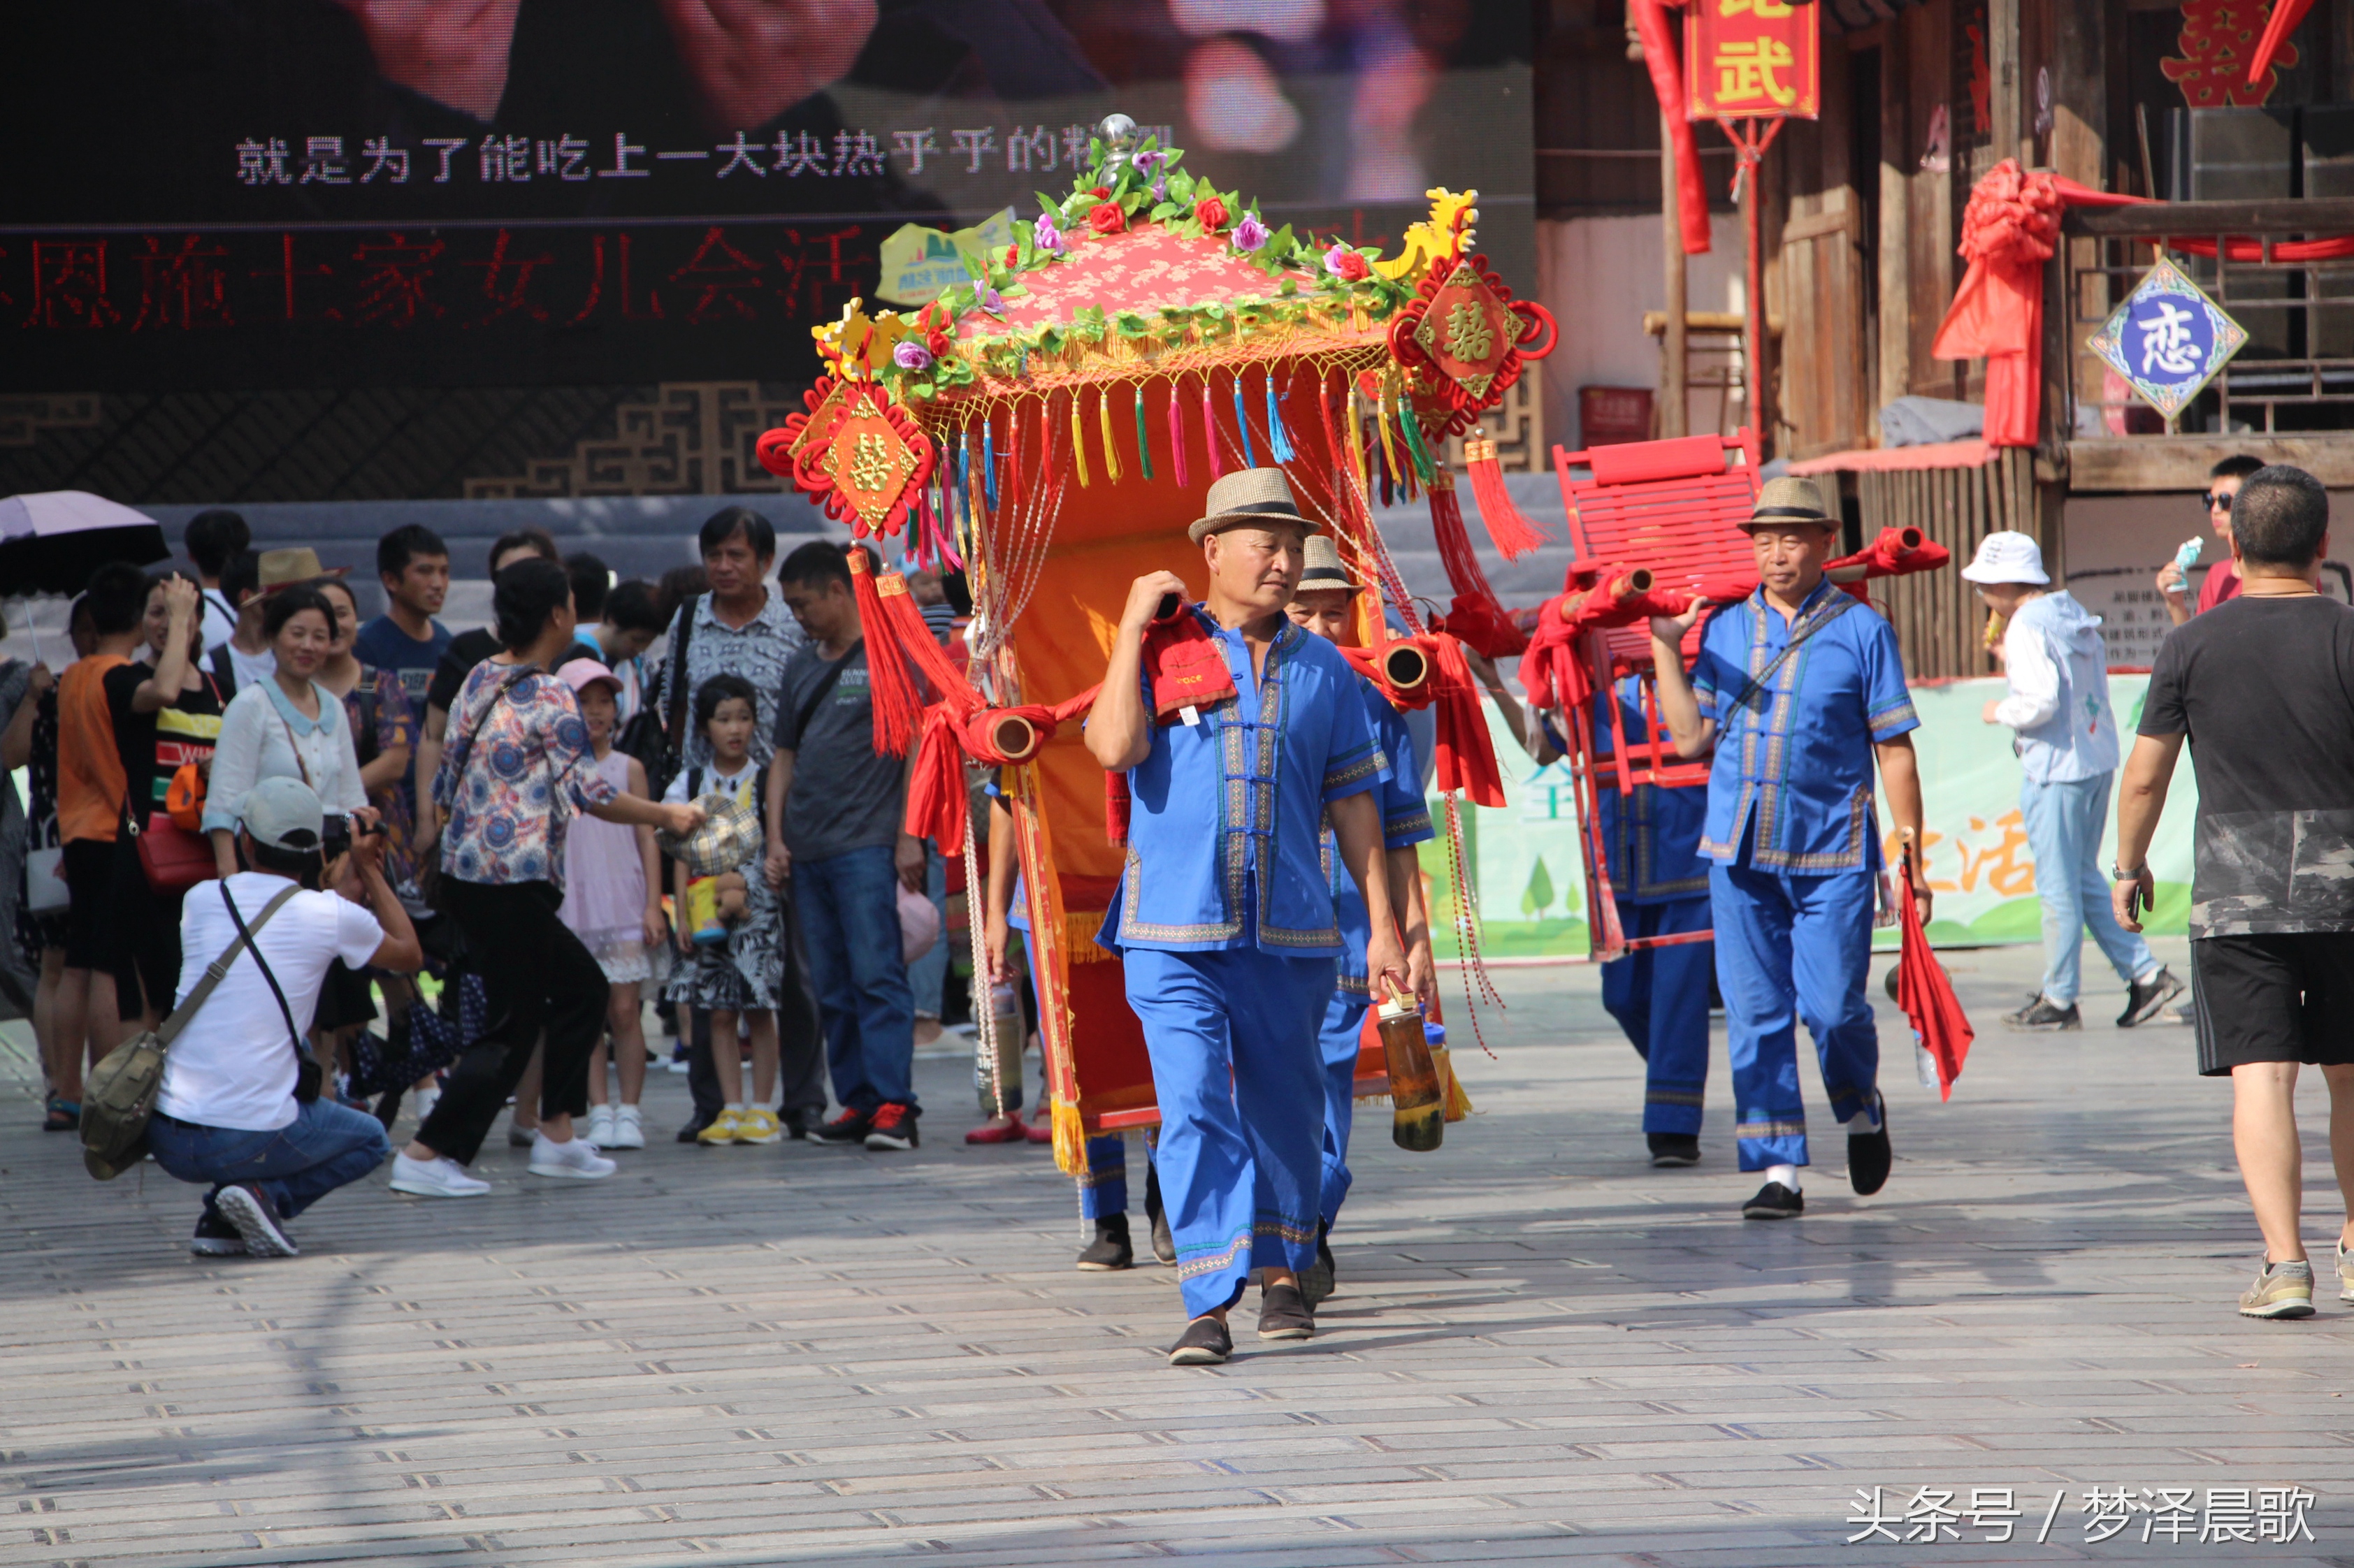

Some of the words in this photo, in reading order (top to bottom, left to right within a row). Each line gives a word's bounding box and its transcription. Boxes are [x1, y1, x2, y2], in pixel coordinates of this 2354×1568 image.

[1714, 0, 1797, 107] 武
[236, 124, 1174, 184] 就是为了能吃上一大块热乎乎的
[2137, 301, 2203, 375] 恋
